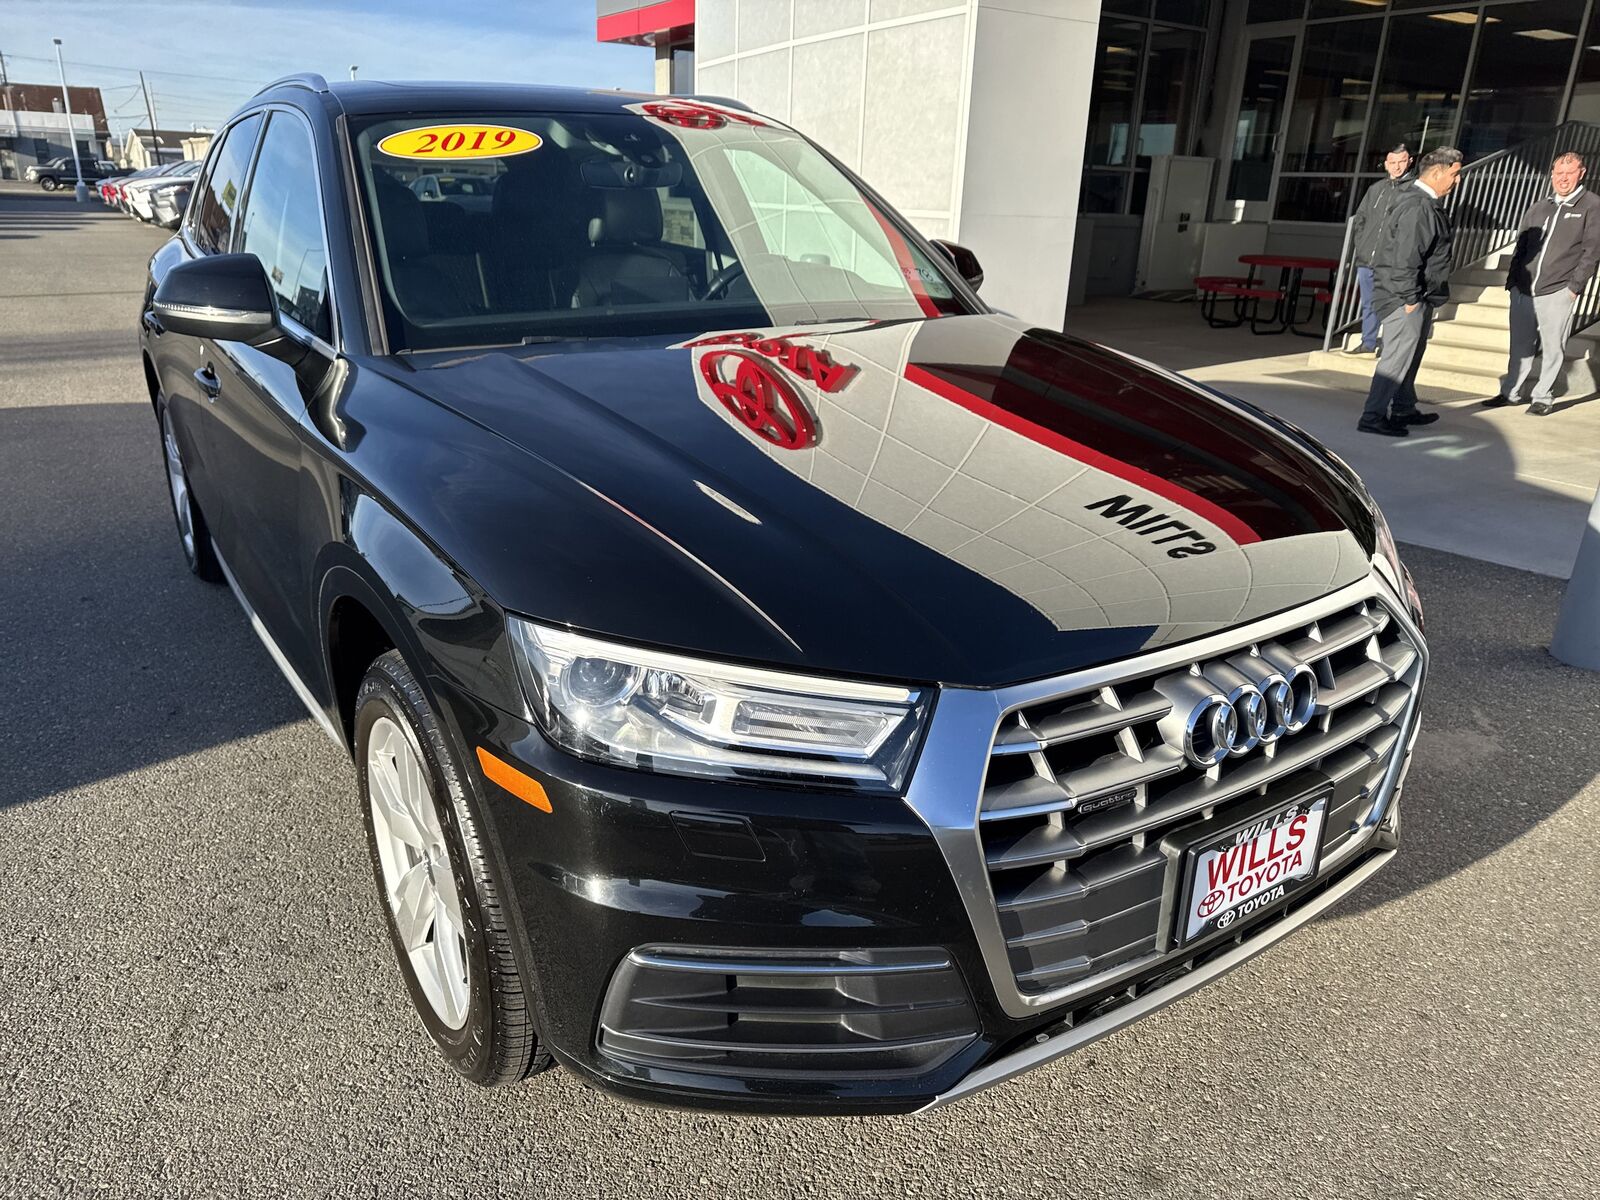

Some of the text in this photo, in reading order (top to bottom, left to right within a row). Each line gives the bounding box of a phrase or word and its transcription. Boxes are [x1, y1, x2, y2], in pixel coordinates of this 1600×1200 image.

[412, 129, 517, 154] 2019
[1082, 791, 1136, 812] quattro
[1235, 805, 1299, 846] WILLS
[1207, 815, 1308, 891] WILLS
[1228, 850, 1303, 902] TOYOTA
[1237, 885, 1285, 918] TOYOTA
